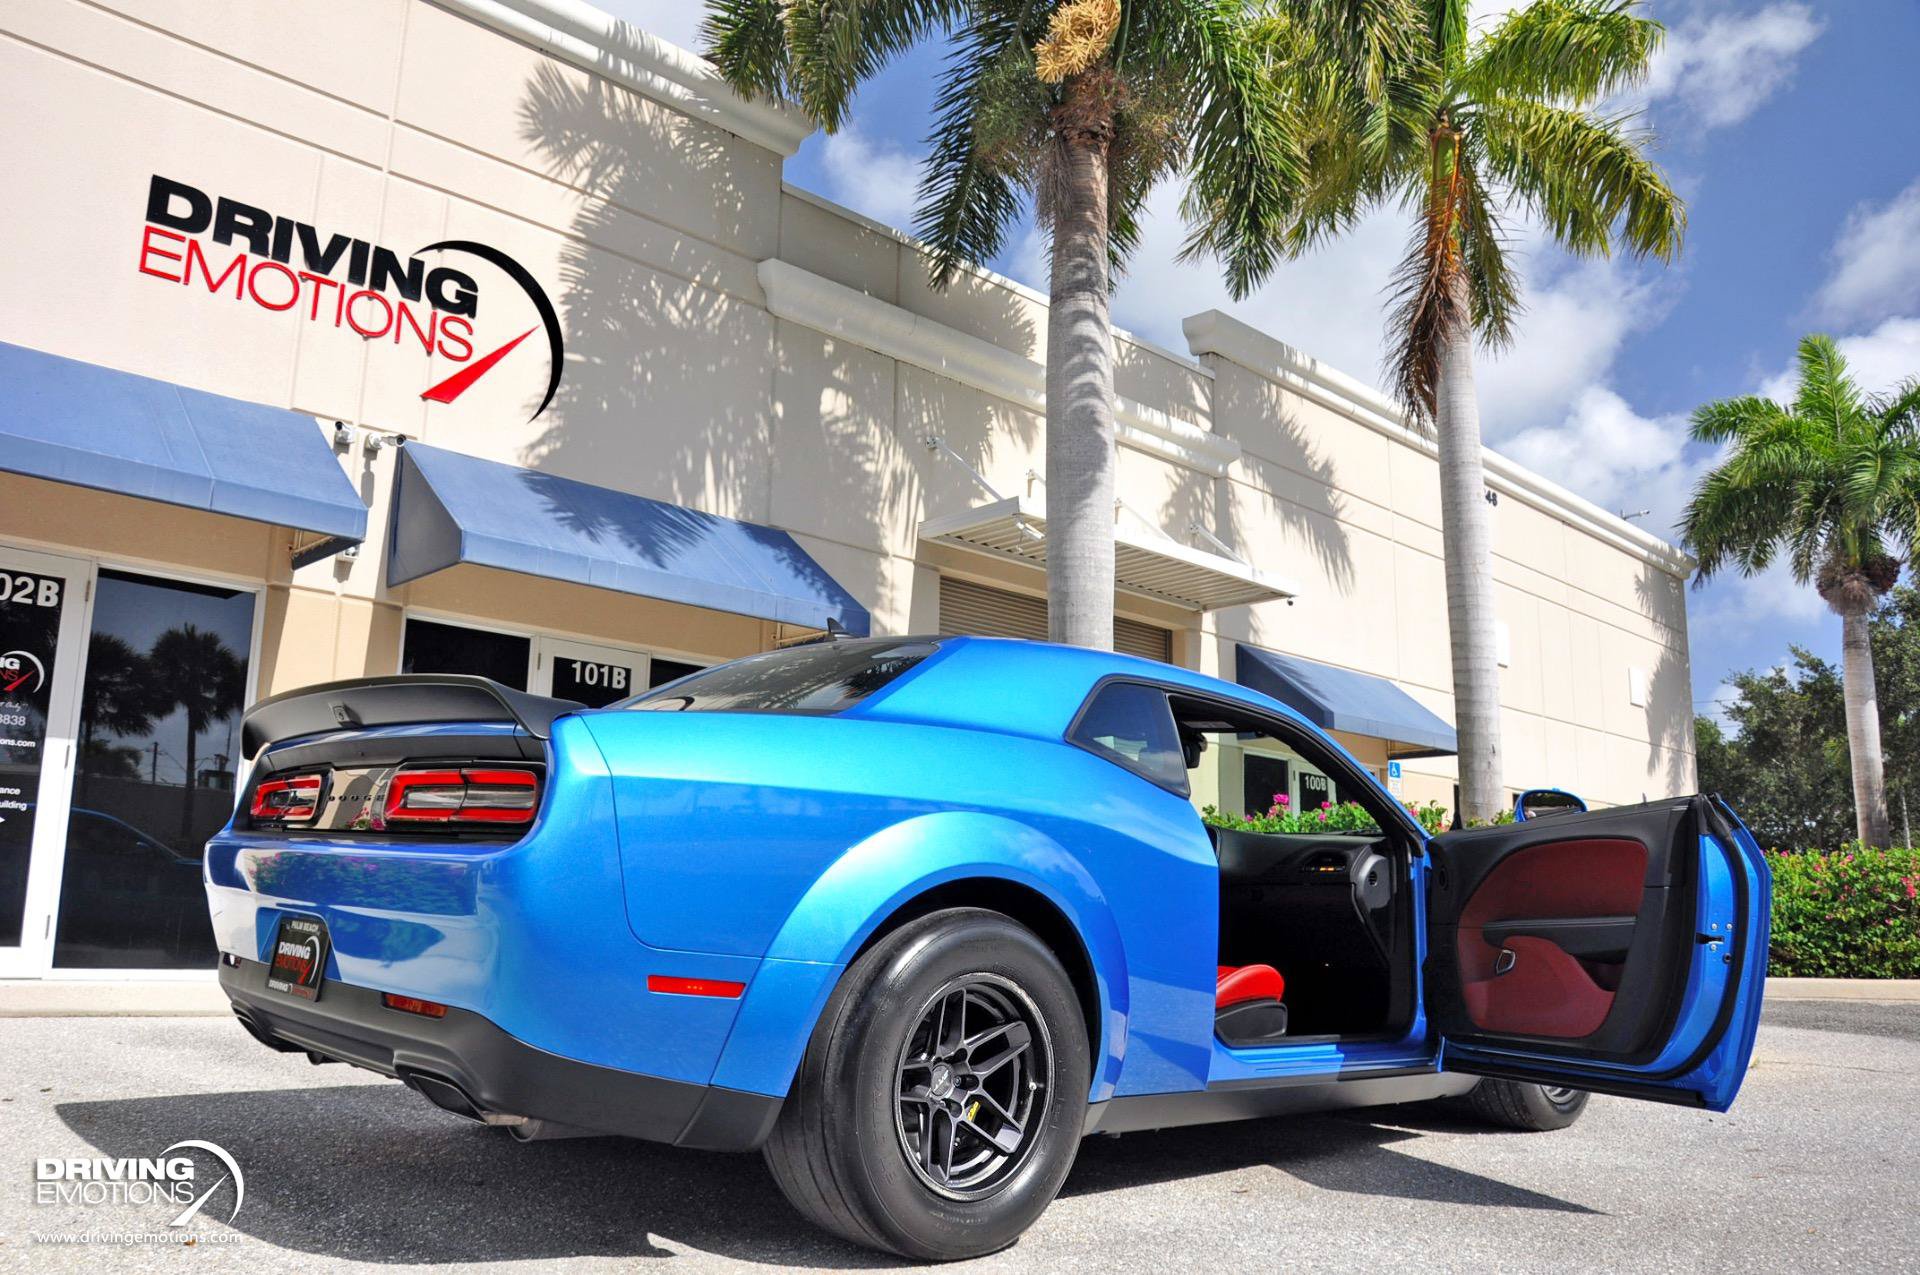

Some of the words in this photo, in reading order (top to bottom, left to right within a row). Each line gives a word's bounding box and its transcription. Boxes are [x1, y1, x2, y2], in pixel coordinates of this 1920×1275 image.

[145, 174, 480, 320] DRIVING
[139, 225, 474, 362] EMOTIONS
[571, 660, 627, 690] 101B
[1304, 774, 1327, 791] 100B
[278, 941, 311, 960] DRIVING
